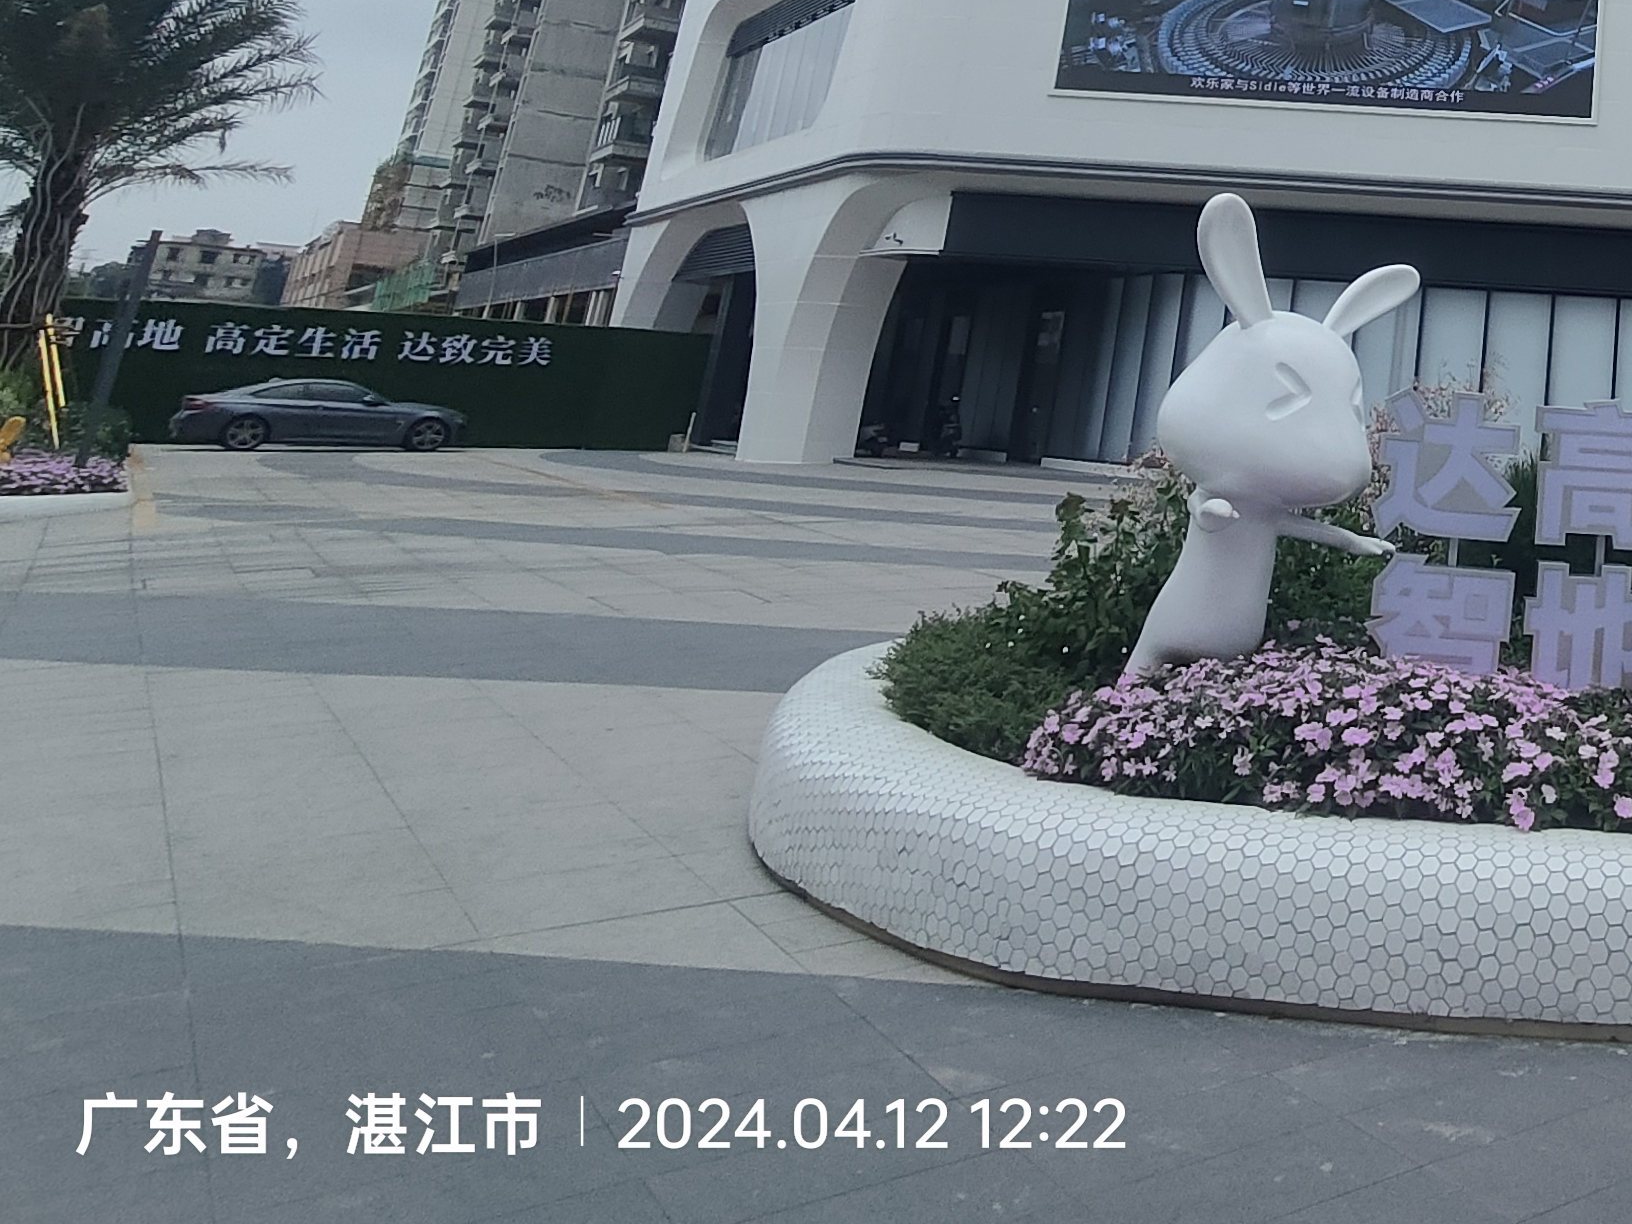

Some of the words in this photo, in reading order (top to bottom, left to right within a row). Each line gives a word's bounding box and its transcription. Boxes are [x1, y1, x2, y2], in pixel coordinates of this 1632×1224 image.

[205, 321, 382, 361] 高定生活
[398, 330, 553, 366] 达致完美
